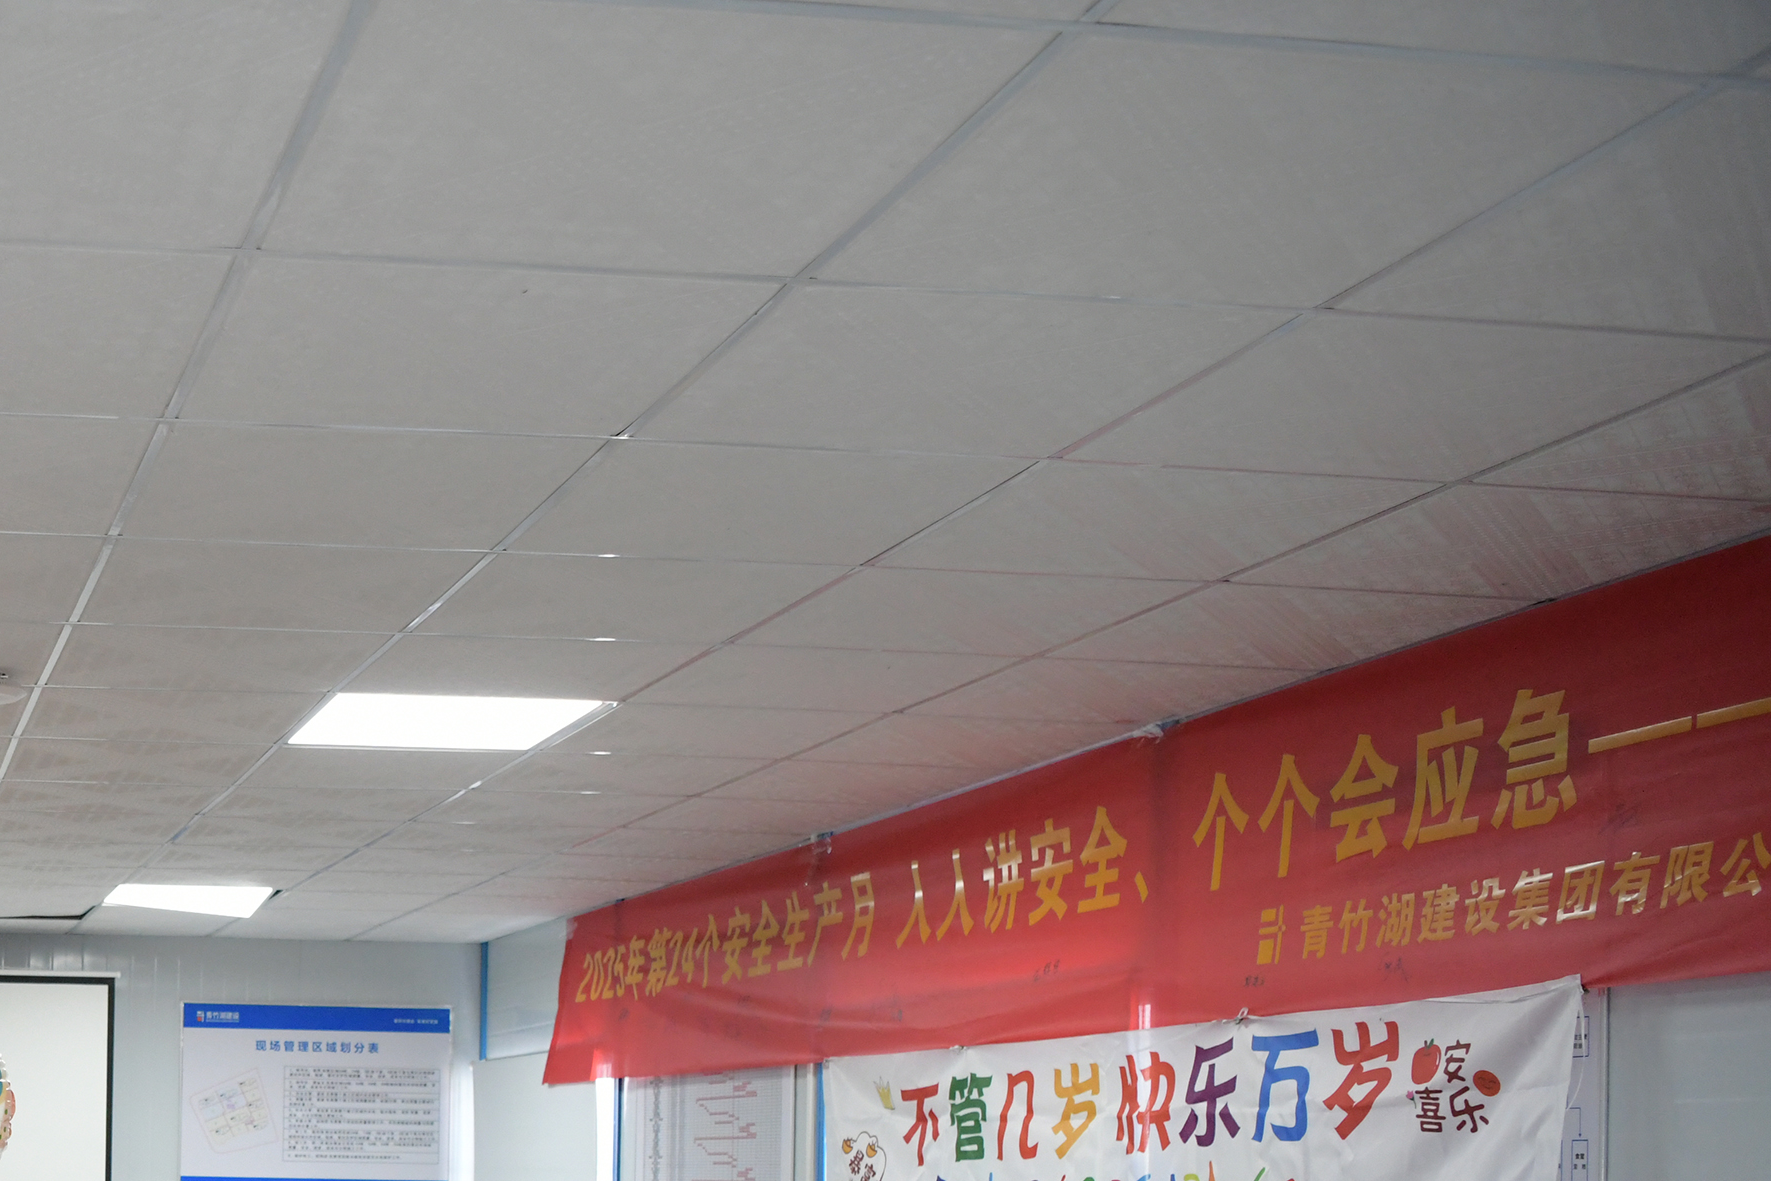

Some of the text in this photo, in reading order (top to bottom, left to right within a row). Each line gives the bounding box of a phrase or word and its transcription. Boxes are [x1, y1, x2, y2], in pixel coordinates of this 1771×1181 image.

[575, 870, 876, 1004] 2025年第24个安全生产月
[1299, 832, 1770, 960] 青竹湖建设集团有限公
[255, 1040, 379, 1054] 现场管理区域划分表
[1415, 1086, 1489, 1133] 喜乐
